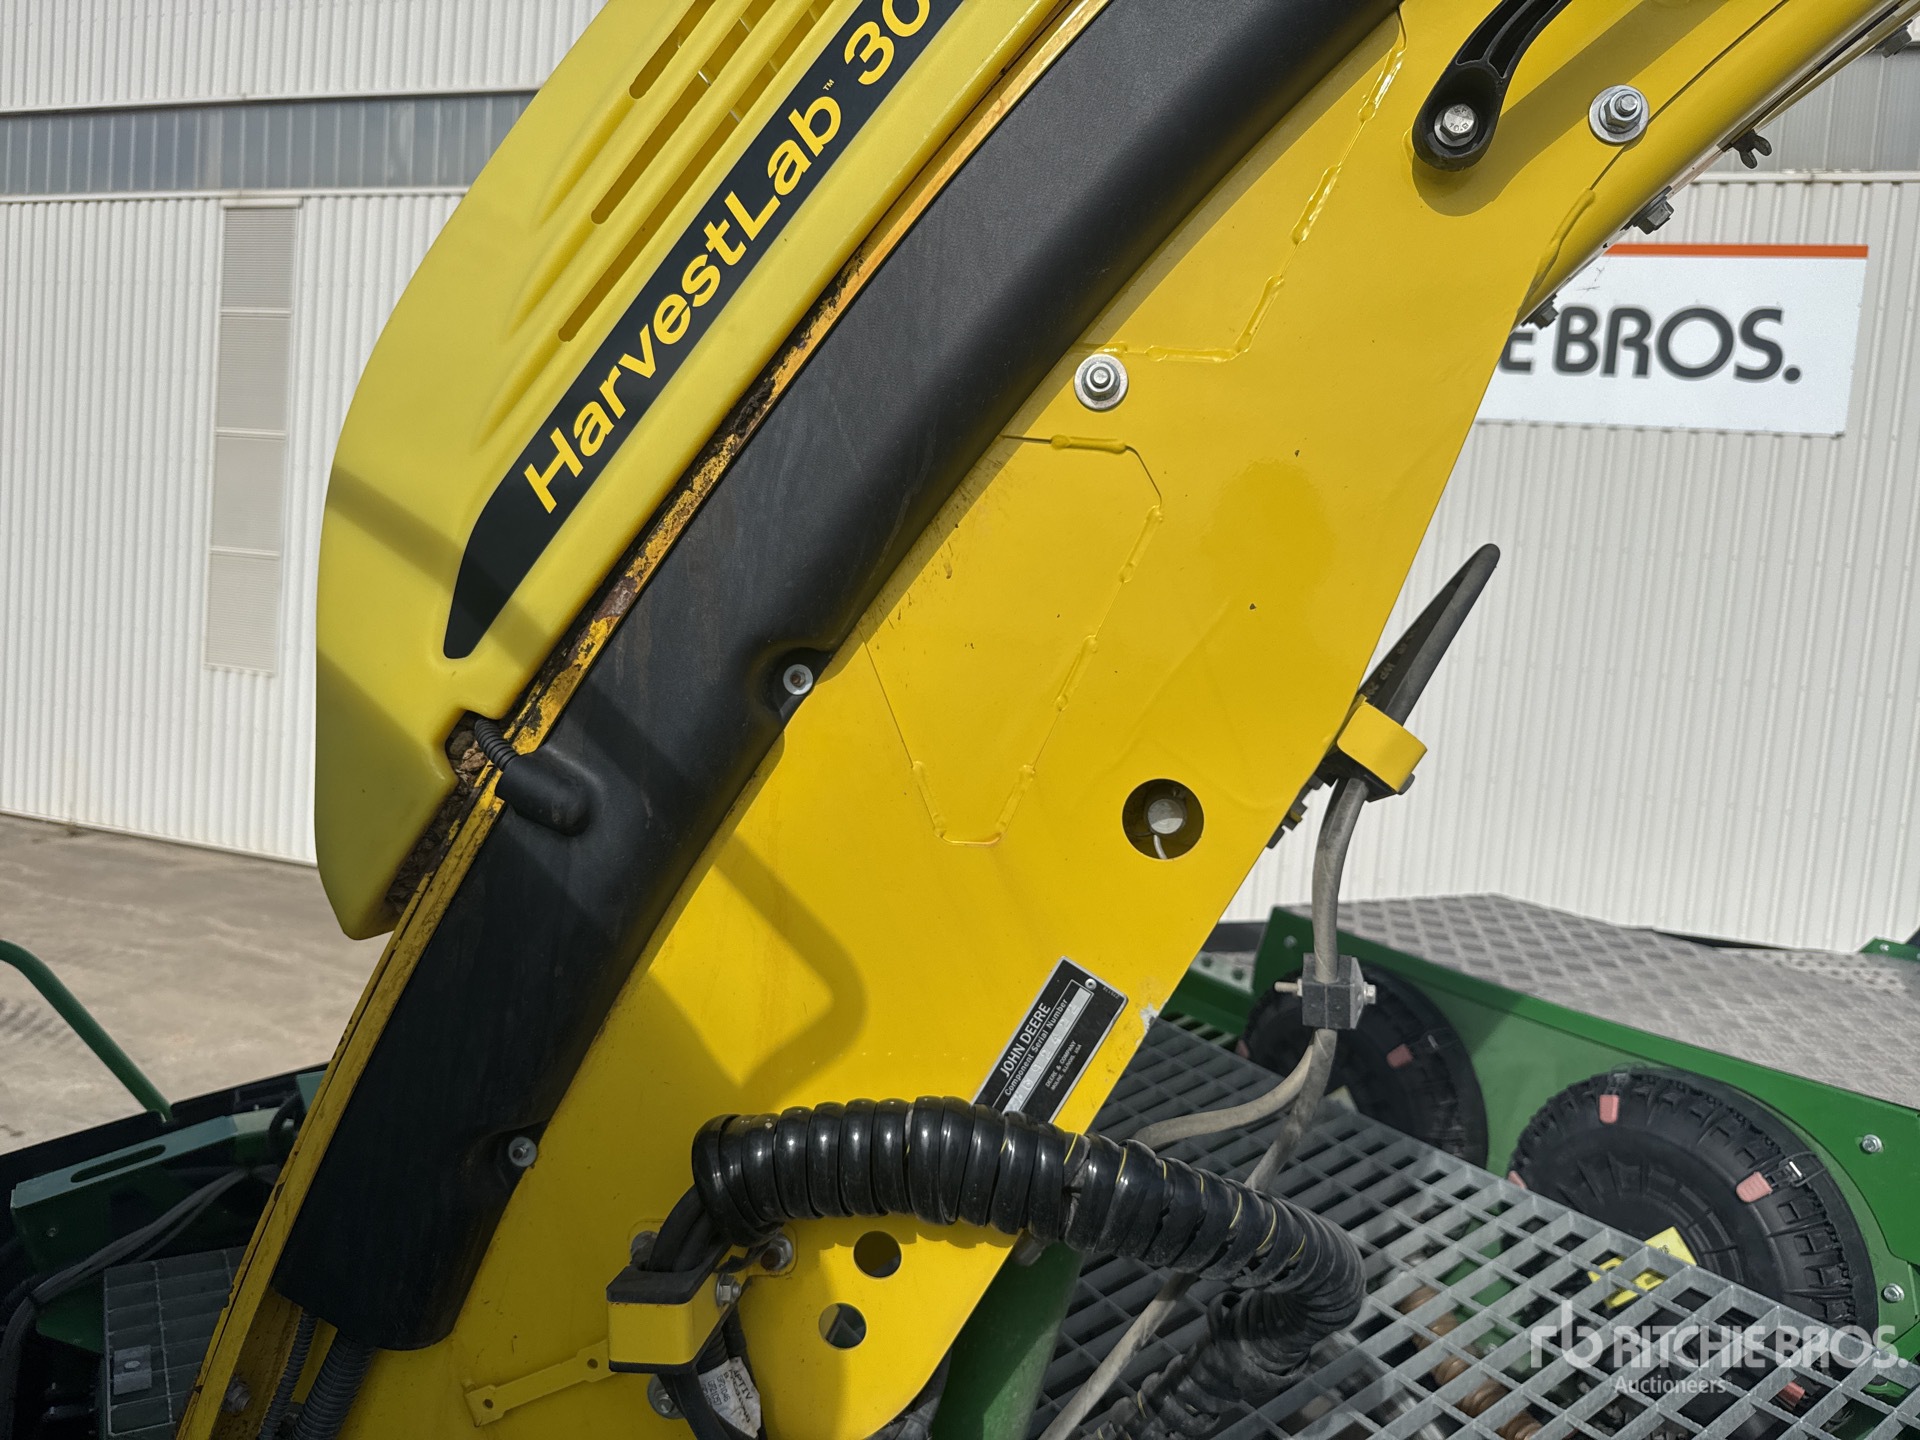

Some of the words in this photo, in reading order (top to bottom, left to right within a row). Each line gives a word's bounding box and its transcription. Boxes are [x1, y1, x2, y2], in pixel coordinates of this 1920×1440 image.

[1555, 306, 1801, 382] BROS.
[1000, 1043, 1026, 1078] JOHN
[1020, 1002, 1051, 1045] DEERE
[1004, 1055, 1035, 1097] Component
[1032, 1030, 1049, 1053] Serial
[1047, 998, 1068, 1030] Number
[1045, 1070, 1058, 1088] DEERE
[1059, 1040, 1077, 1065] COMPANY
